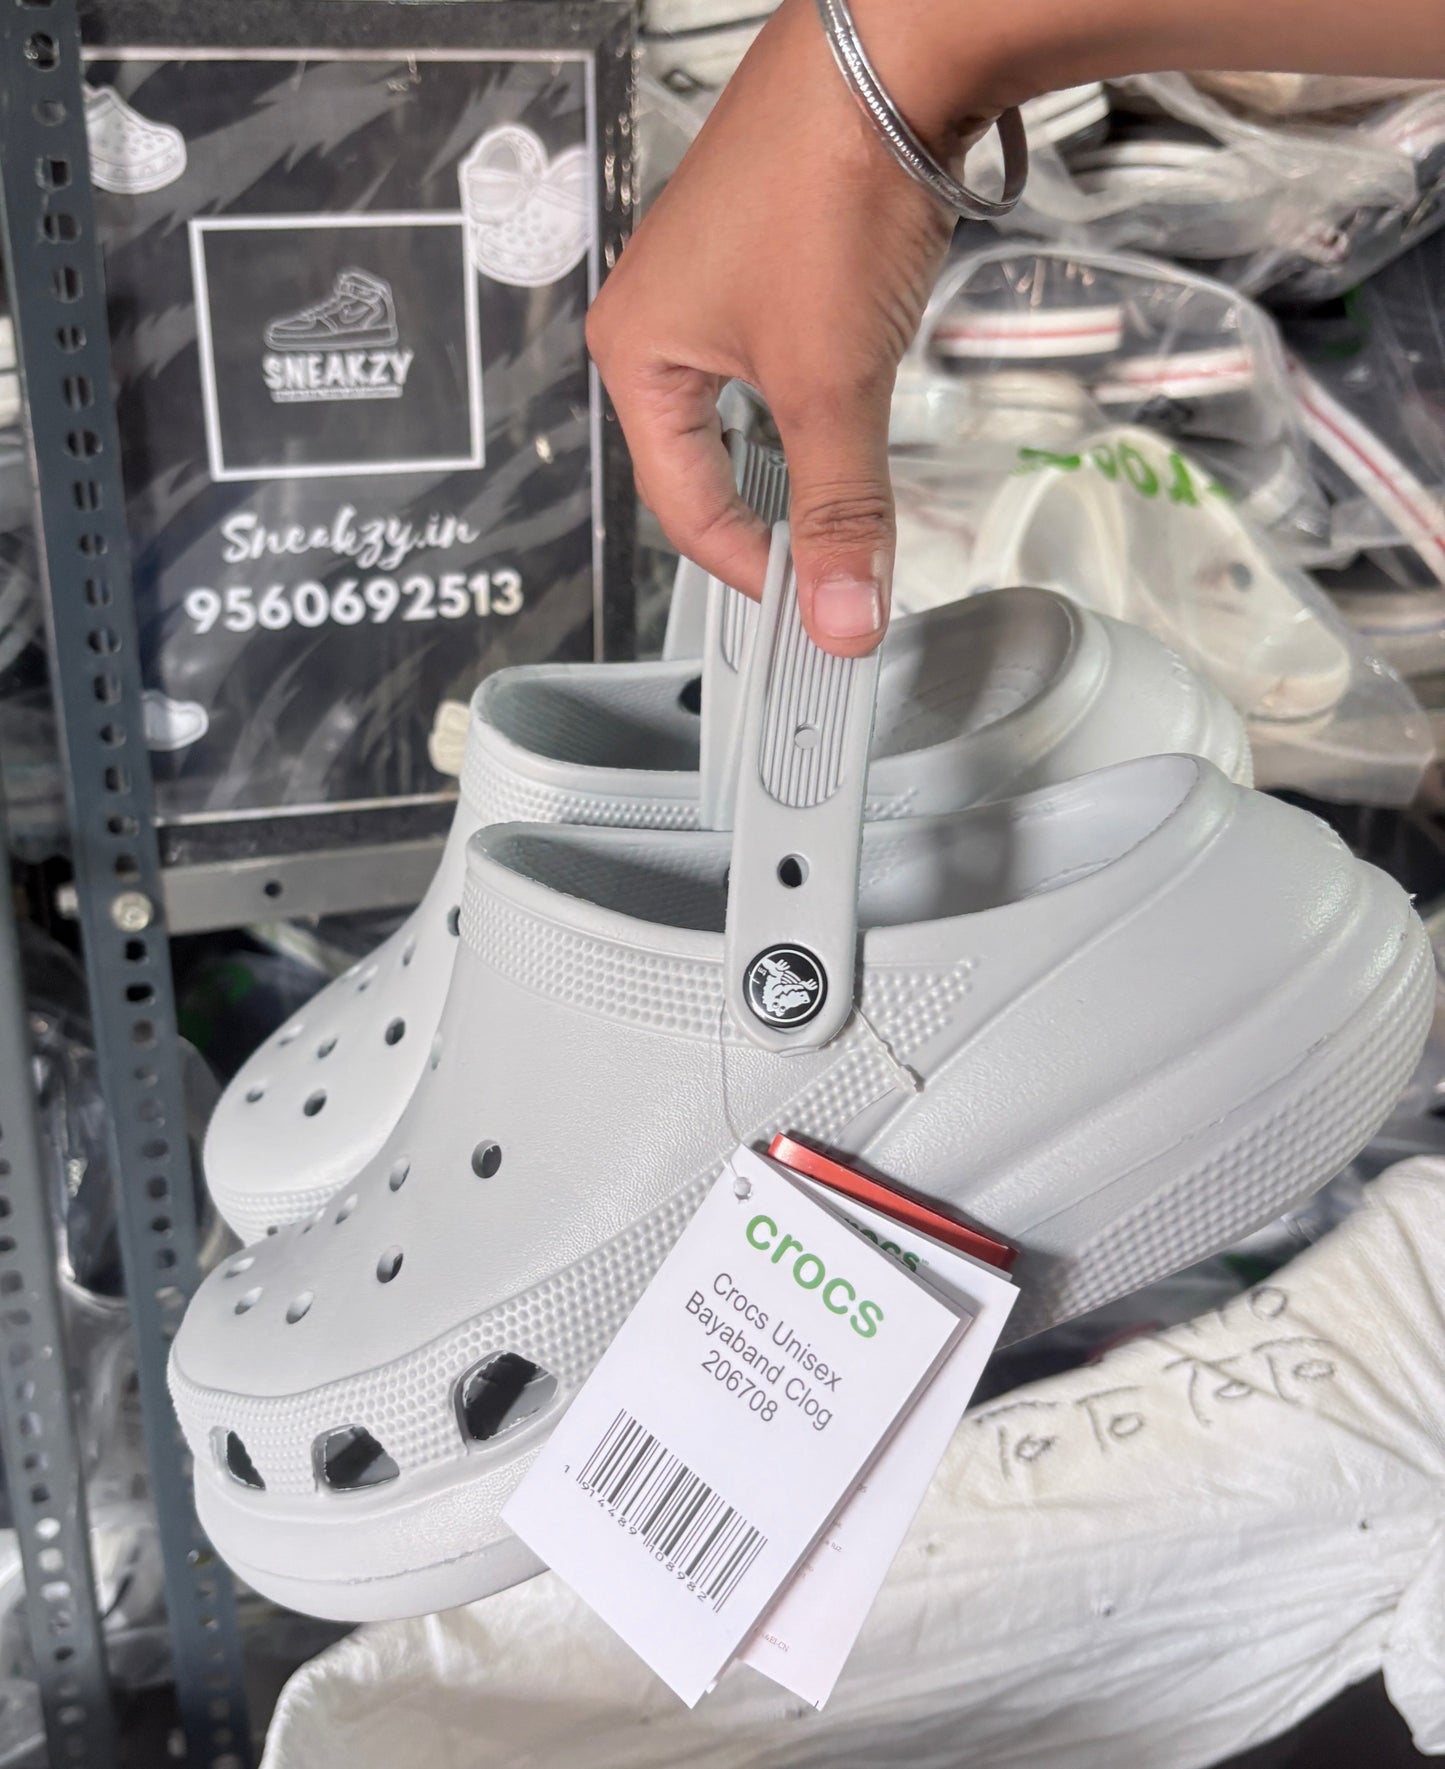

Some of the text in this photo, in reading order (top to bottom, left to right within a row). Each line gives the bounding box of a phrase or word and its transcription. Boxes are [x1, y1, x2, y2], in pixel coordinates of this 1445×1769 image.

[262, 349, 414, 389] SNEAKZY
[184, 567, 525, 635] 9560692513
[745, 1214, 885, 1338] crocs
[685, 1290, 834, 1432] Bayaband Clog
[712, 1272, 843, 1393] Crocs Unisex
[701, 1349, 779, 1423] 206708
